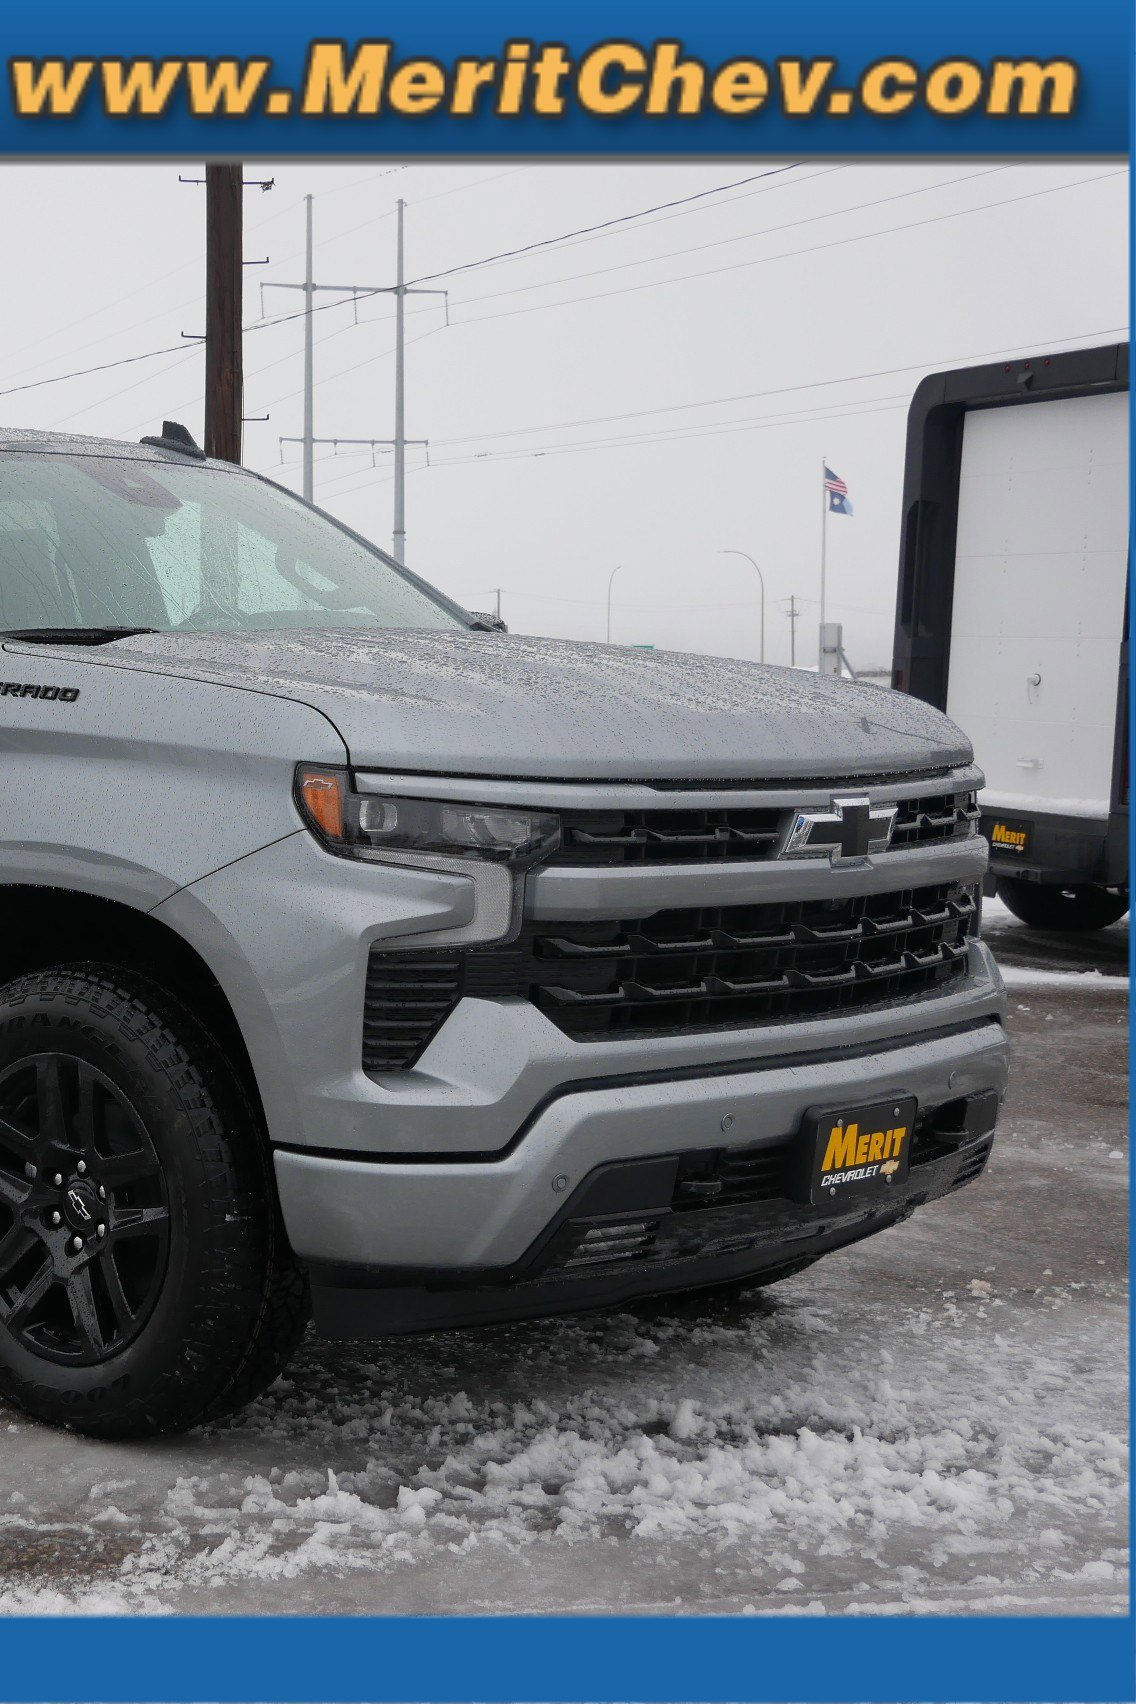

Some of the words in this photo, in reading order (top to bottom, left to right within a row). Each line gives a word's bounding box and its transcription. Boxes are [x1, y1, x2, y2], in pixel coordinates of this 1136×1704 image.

[991, 824, 1026, 845] MERIT
[821, 1123, 907, 1172] MERIT
[821, 1165, 880, 1187] CHEVROLET
